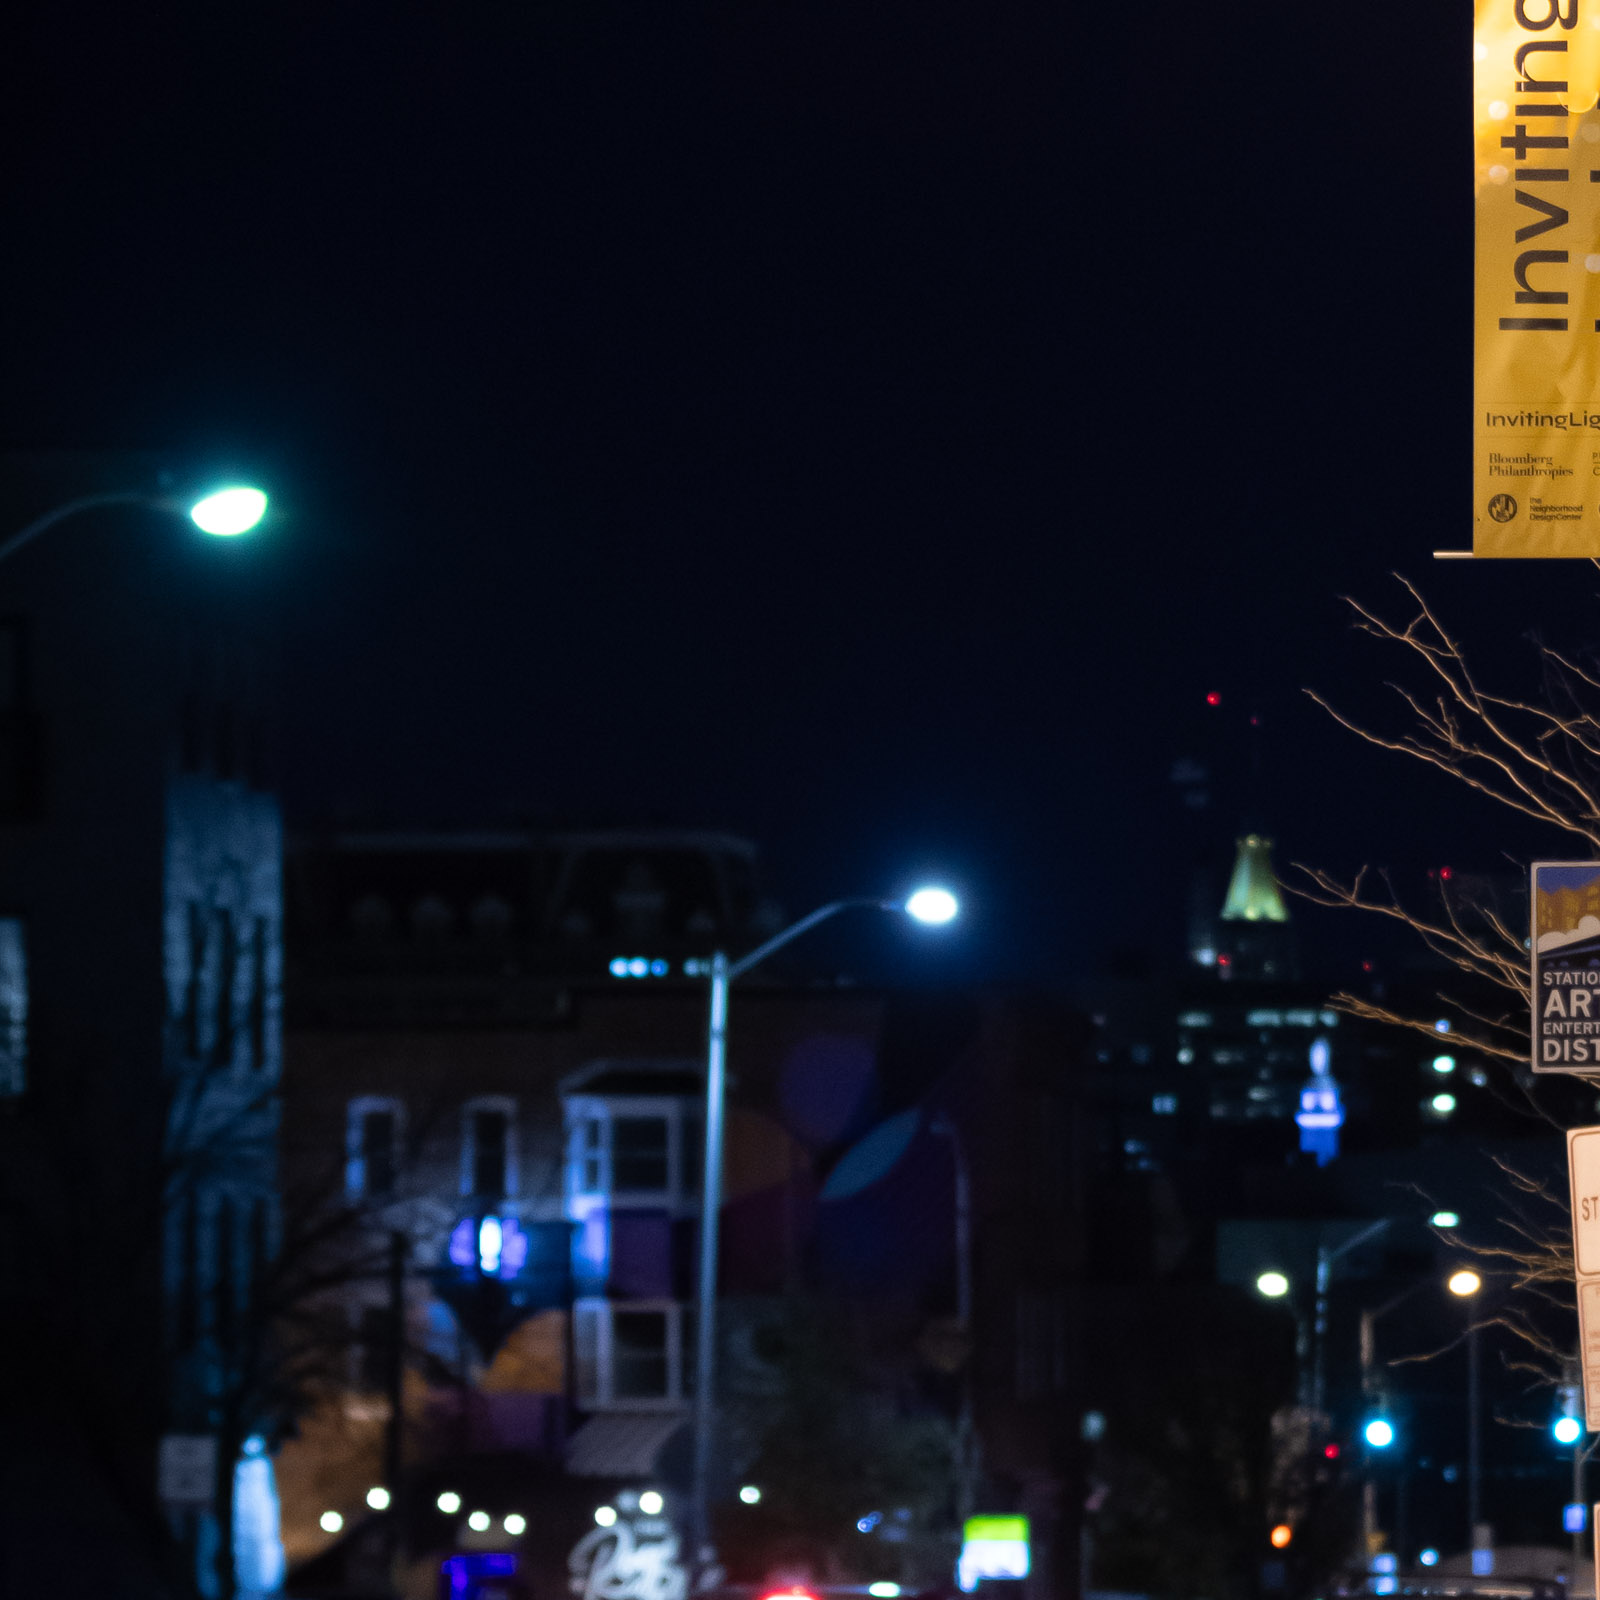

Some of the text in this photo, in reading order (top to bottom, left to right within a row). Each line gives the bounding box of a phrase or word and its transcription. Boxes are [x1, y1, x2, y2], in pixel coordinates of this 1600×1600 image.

[1488, 452, 1554, 466] Bloomberg
[1488, 464, 1574, 480] Philanthropies
[1529, 504, 1584, 515] Neighborhood
